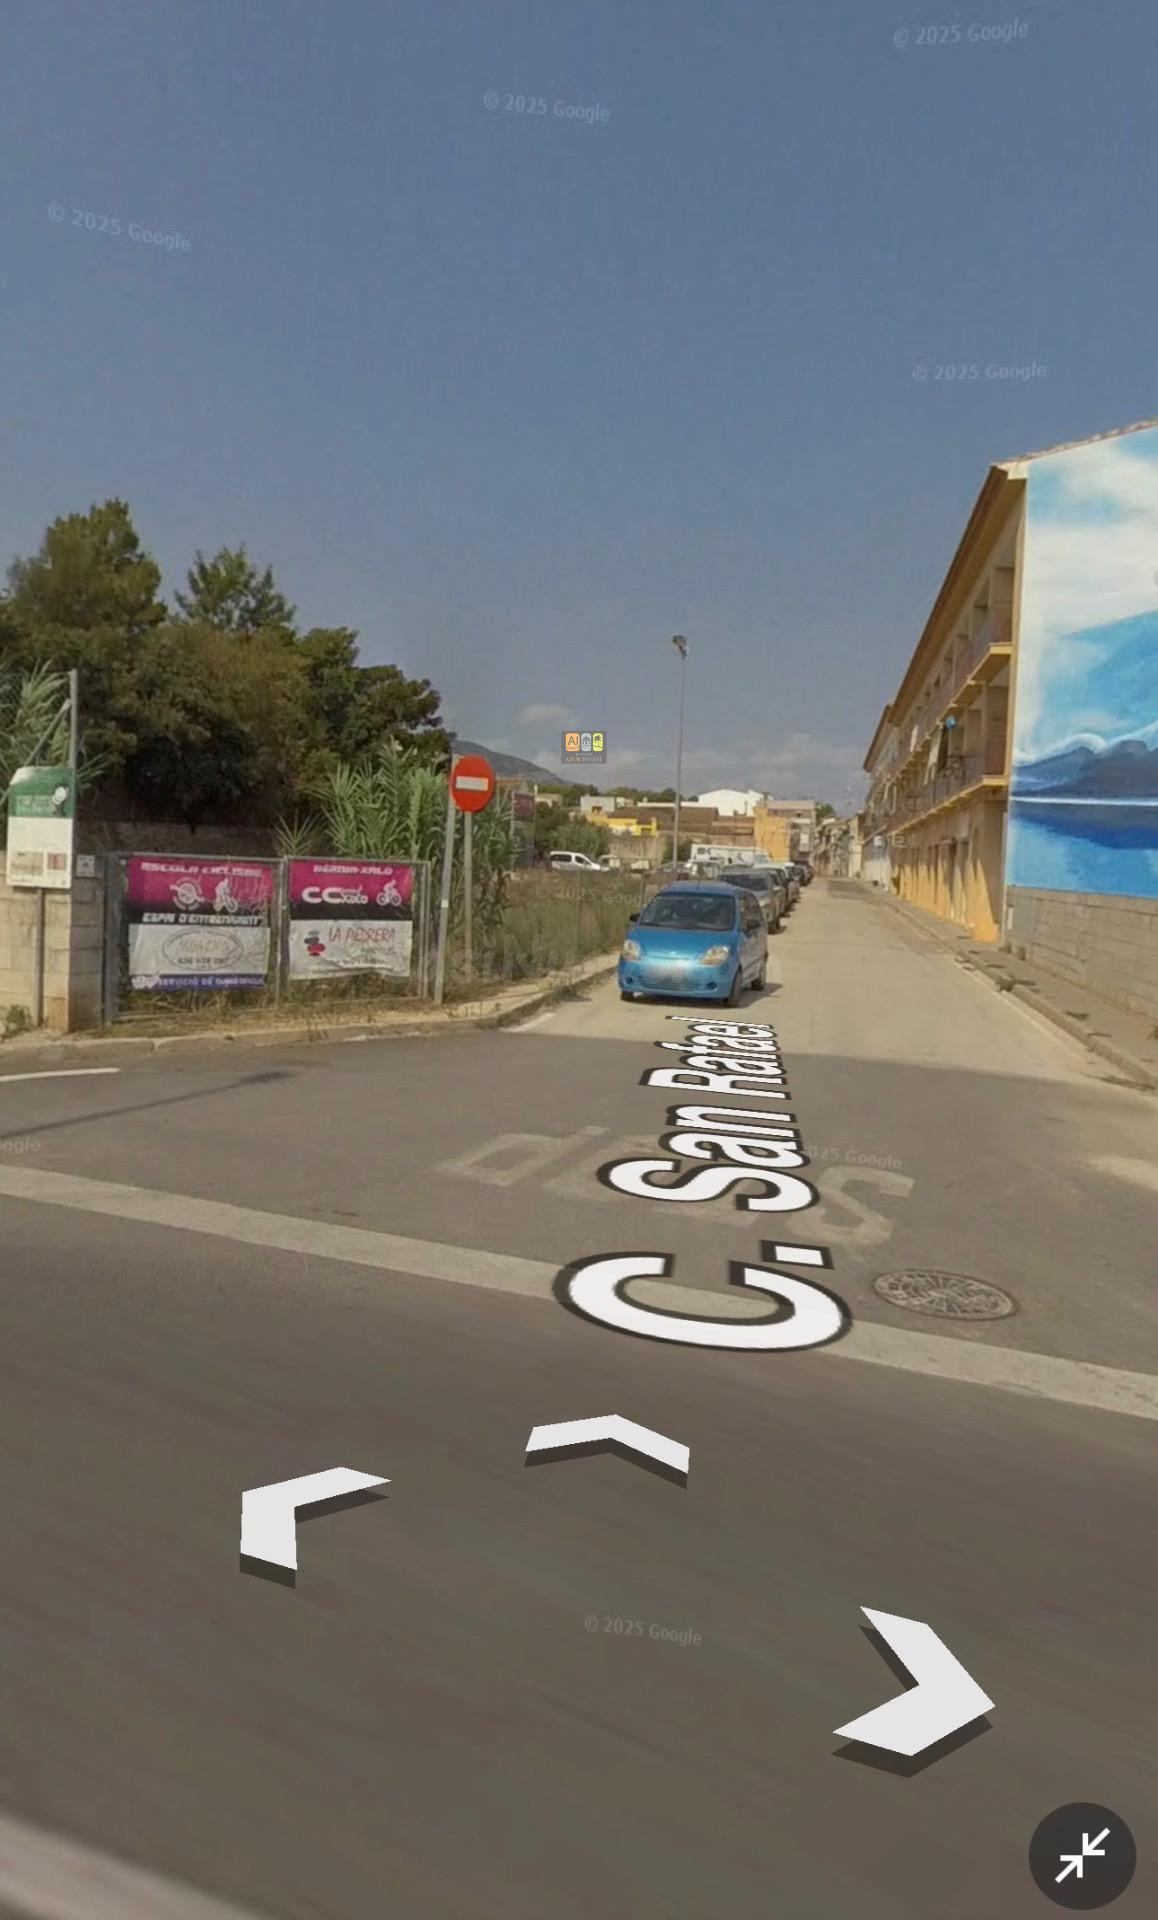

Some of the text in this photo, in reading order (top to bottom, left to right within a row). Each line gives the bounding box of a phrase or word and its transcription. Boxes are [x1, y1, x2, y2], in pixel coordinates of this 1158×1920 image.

[302, 886, 343, 904] CC
[328, 926, 396, 943] LA PEDRERA
